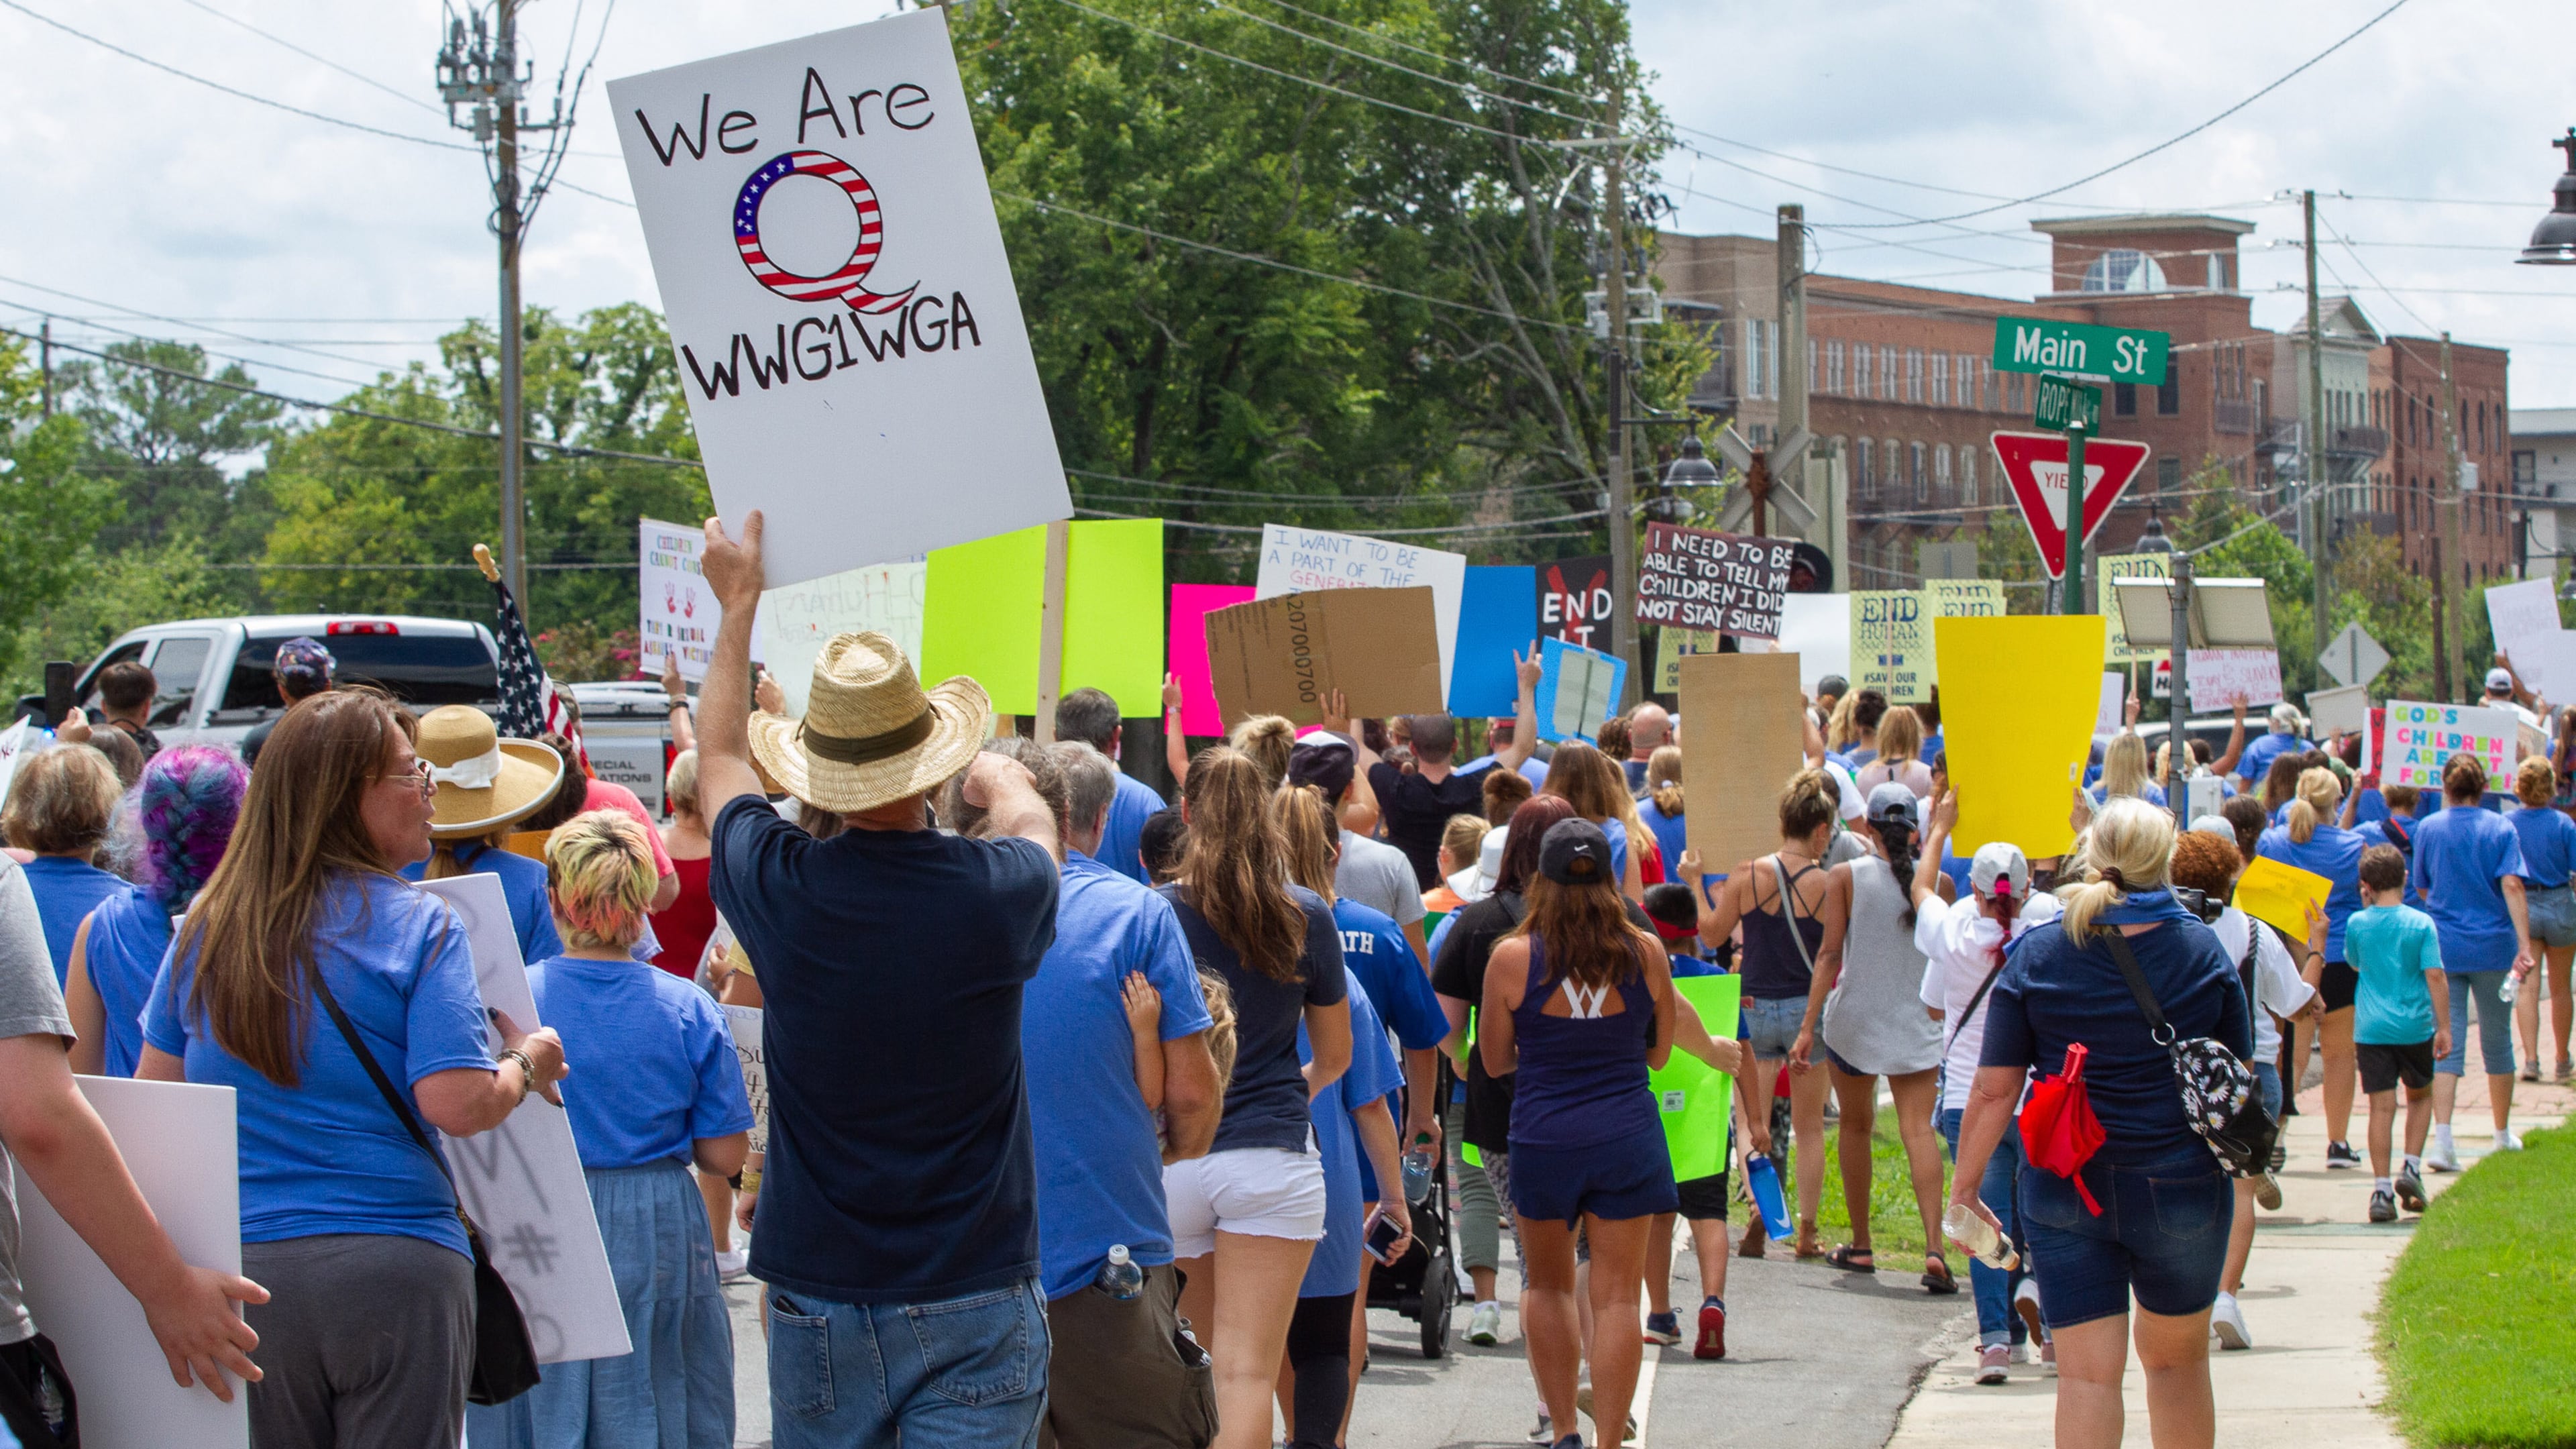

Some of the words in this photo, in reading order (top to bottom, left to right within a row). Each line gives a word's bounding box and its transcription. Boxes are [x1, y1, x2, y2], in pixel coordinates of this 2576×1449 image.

[635, 93, 759, 166] We
[798, 67, 934, 144] Are
[733, 150, 920, 315] Q
[681, 291, 981, 400] WWG1WGA
[2014, 326, 2086, 369] Main
[2112, 335, 2148, 374] St
[2044, 472, 2089, 490] YIED
[1275, 530, 1289, 545] I
[1300, 533, 1352, 555] WANT
[1366, 542, 1389, 562] TO
[1396, 547, 1419, 569] BE
[1654, 529, 1660, 549] I
[1672, 532, 1729, 559] NEED
[1737, 542, 1764, 564] TO
[1770, 545, 1794, 570] BE
[1268, 549, 1280, 564] A
[1291, 551, 1336, 572] PART
[1346, 561, 1368, 578] OF
[1380, 568, 1415, 587] THE
[1644, 552, 1688, 576] ABLE
[1695, 558, 1720, 578] TO
[1723, 561, 1764, 590] TELL
[1767, 572, 1790, 593] MY
[1543, 588, 1613, 623] END
[1637, 599, 1679, 621] NOT
[1682, 602, 1726, 629] STAY
[1739, 588, 1754, 608] I
[1756, 590, 1786, 612] DID
[1558, 625, 1595, 649] IT
[1896, 672, 1917, 683] OUR
[2395, 706, 2458, 724] GOD'S
[2397, 727, 2503, 754] CHILDREN
[2405, 748, 2449, 767] ARE
[2400, 767, 2443, 786] FOR
